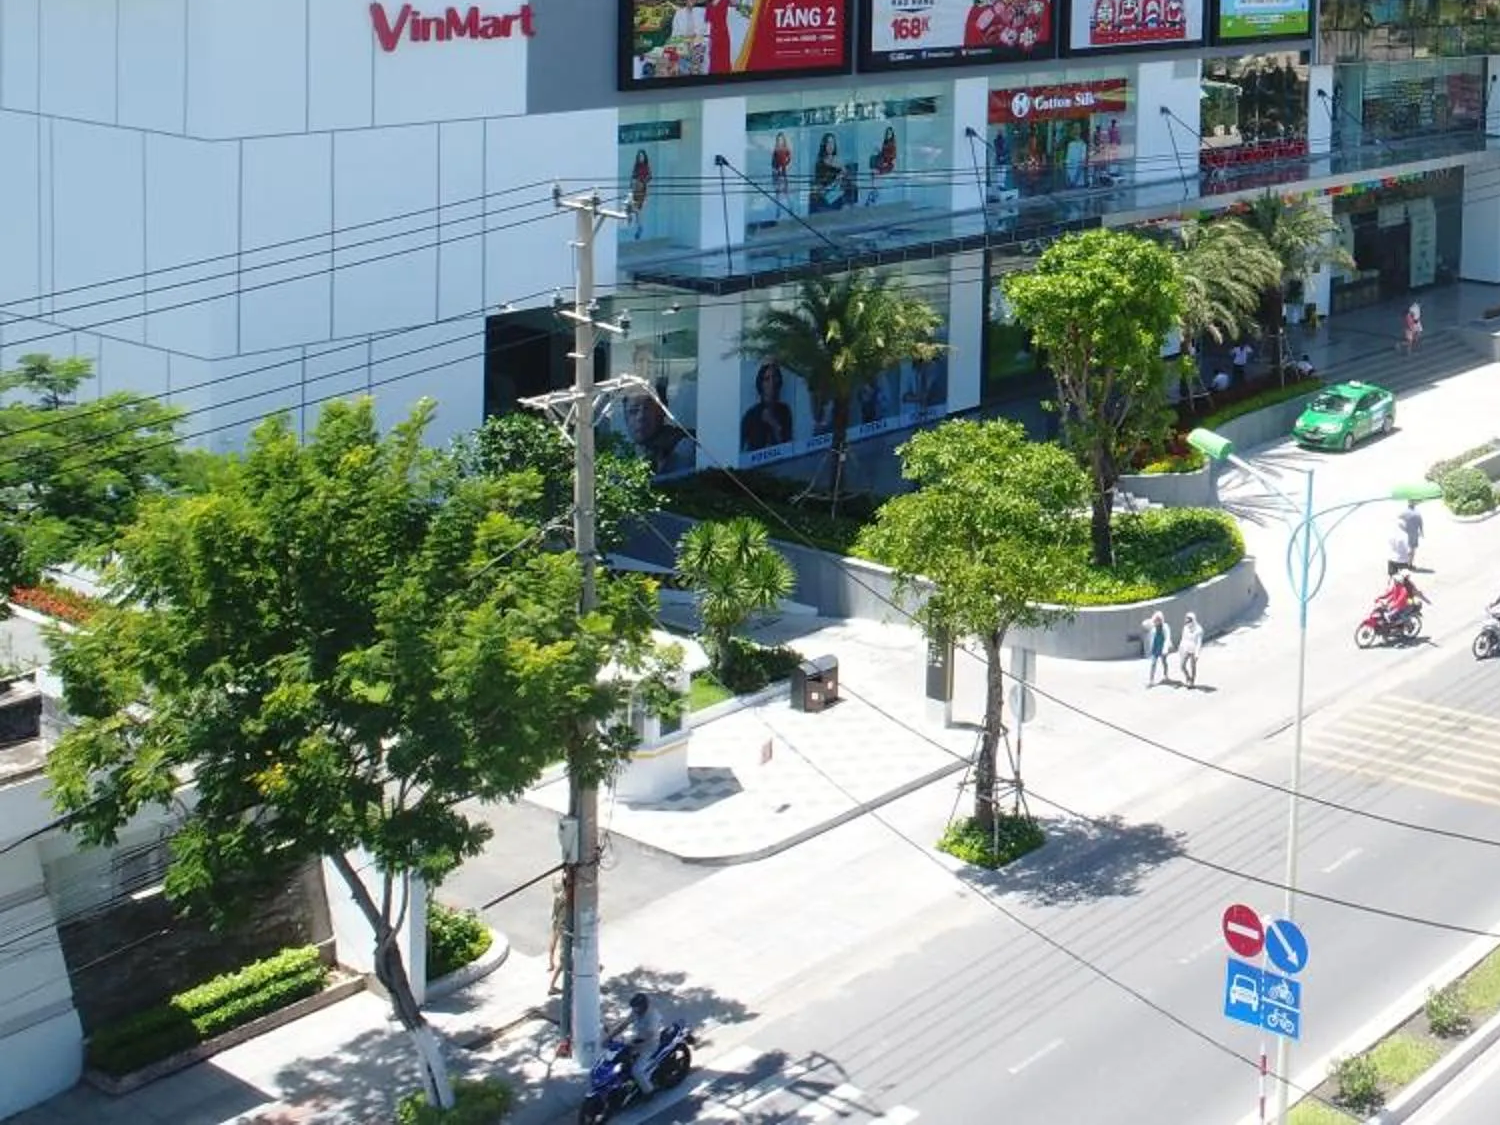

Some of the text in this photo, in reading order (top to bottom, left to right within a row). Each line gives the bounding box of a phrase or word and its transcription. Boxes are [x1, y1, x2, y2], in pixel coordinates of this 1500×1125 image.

[827, 7, 836, 25] 2
[369, 2, 536, 52] VinMart
[1034, 92, 1095, 110] Cotton Silk
